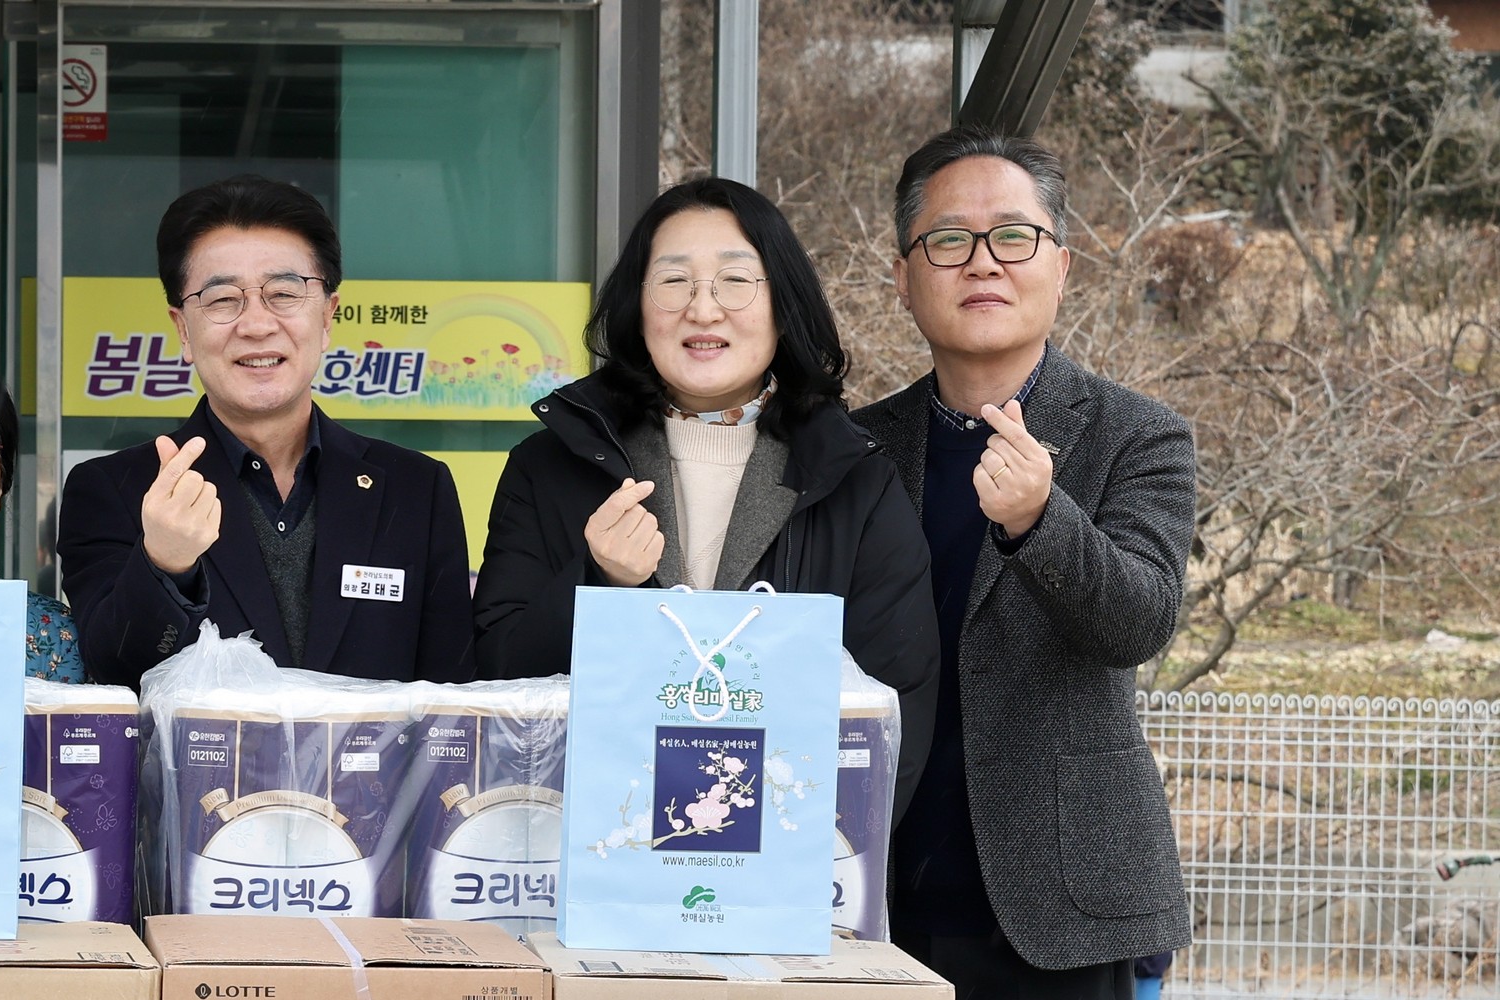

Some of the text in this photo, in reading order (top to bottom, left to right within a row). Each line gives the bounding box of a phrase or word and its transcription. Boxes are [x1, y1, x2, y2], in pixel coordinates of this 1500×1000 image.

[370, 305, 428, 324] 함께한
[661, 713, 759, 725] Hong Family
[190, 750, 226, 762] 0121102
[430, 746, 466, 758] 0121102
[445, 787, 465, 804] New
[205, 793, 225, 808] New
[235, 793, 276, 811] Premium
[662, 855, 745, 868] www.maesil.co.kr
[210, 877, 353, 912] 크리넥스
[681, 912, 725, 923] 청매실농원
[216, 986, 276, 998] LOTTE
[480, 986, 518, 995] 상품개별
